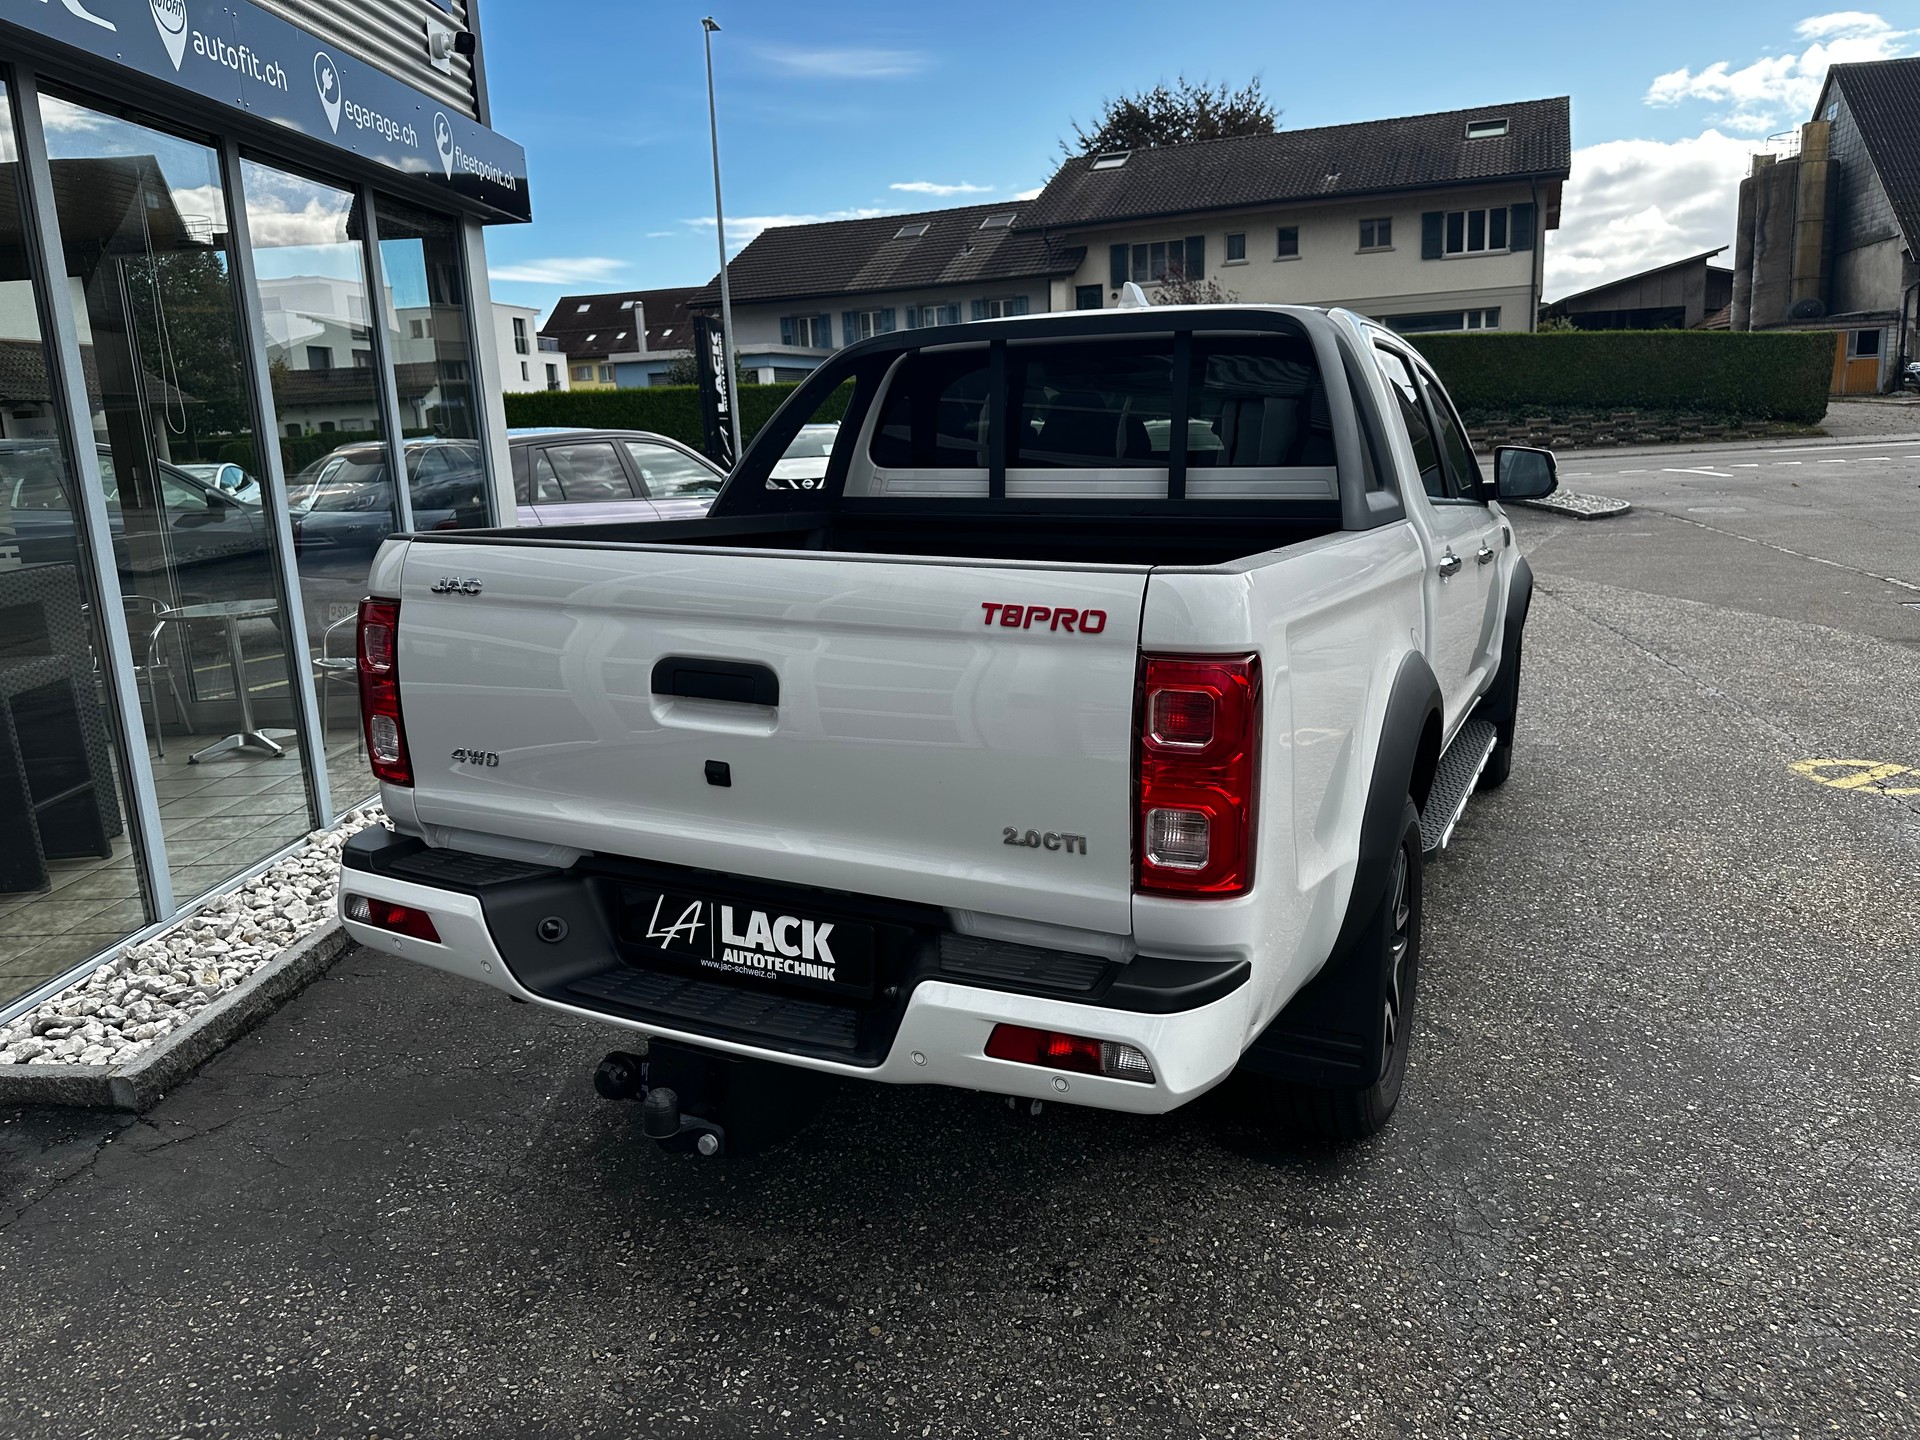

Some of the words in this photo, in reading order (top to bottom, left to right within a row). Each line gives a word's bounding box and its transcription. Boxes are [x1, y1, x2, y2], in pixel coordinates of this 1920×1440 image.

[192, 30, 288, 92] autofit.ch
[344, 100, 419, 148] egarage.ch
[455, 145, 517, 191] fleetpoint.ch
[710, 330, 726, 412] LACK
[431, 577, 482, 596] JAC
[981, 602, 1107, 634] T8PRO
[451, 747, 499, 767] 4WD
[1003, 826, 1087, 855] 2.0CTI
[721, 904, 836, 964] LACK
[700, 958, 777, 980] www.jac-schweiz.ch
[722, 948, 836, 982] AUTOTECHNIK
